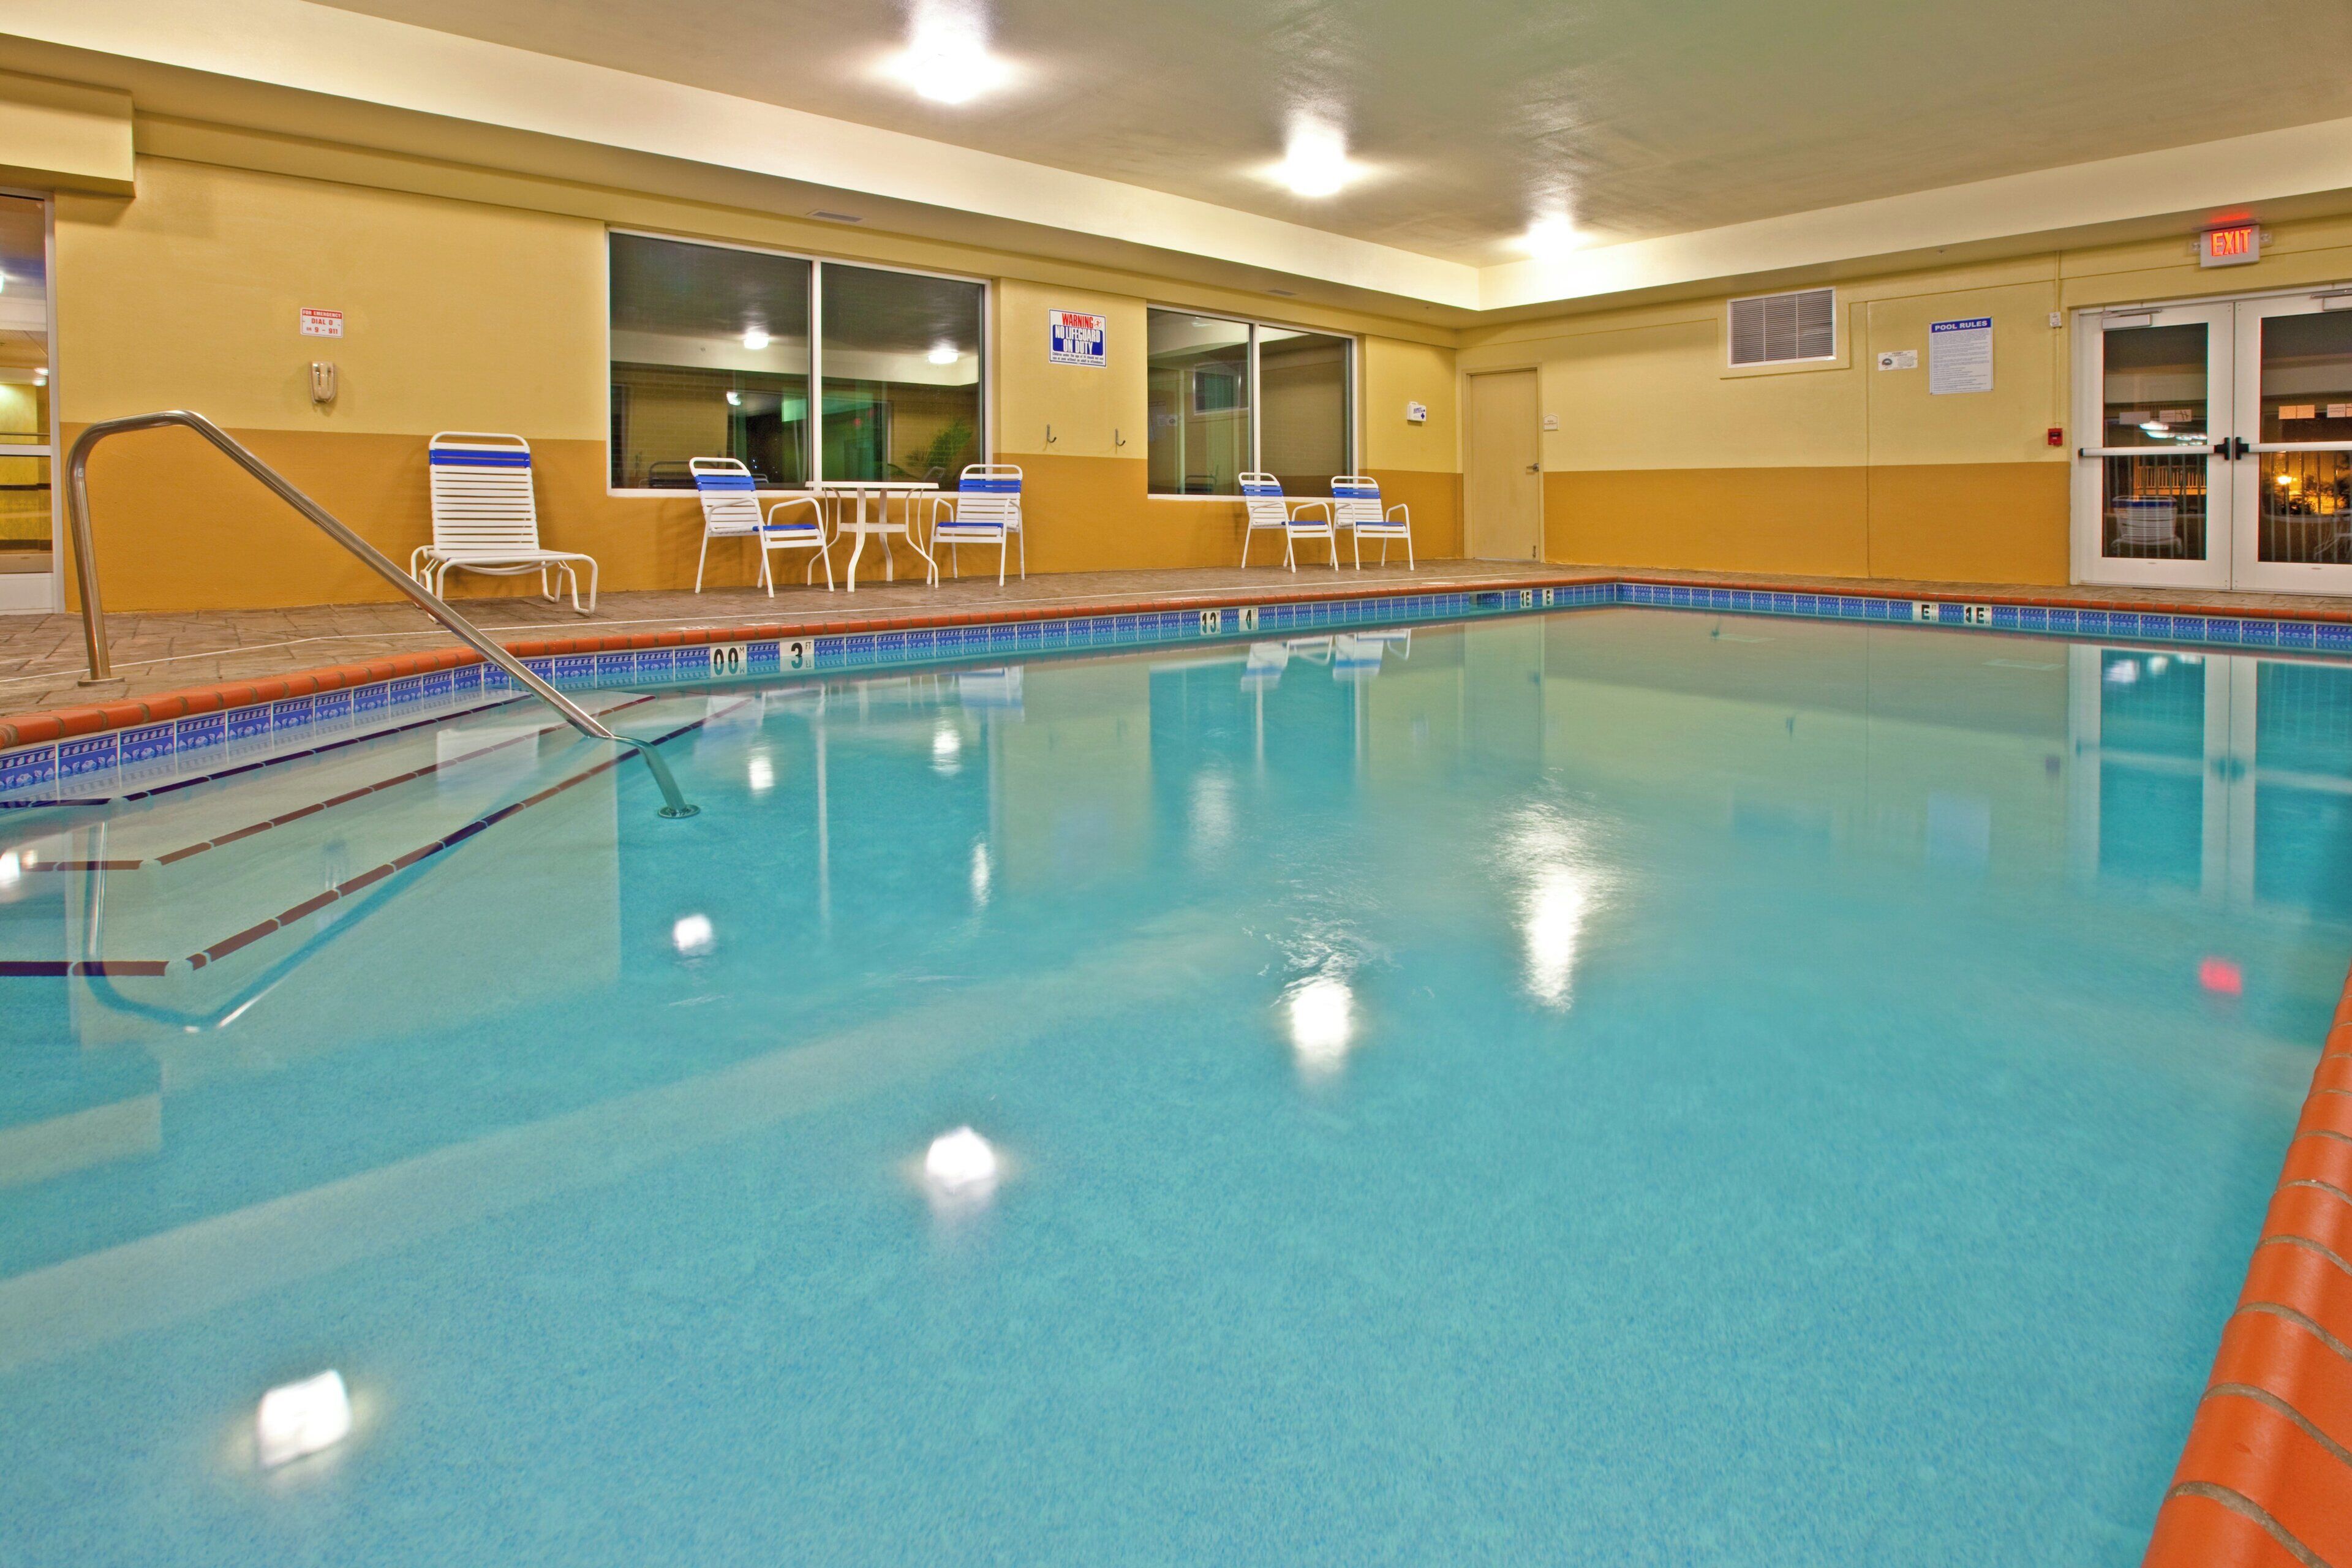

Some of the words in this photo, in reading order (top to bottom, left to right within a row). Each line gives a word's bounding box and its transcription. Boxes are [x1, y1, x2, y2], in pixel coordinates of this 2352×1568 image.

[2211, 228, 2252, 257] EXIT
[1061, 313, 1093, 328] WARNING
[1959, 320, 1988, 329] RULES
[1055, 325, 1065, 339] NO
[1065, 326, 1101, 343] LIFEGUARD
[1063, 339, 1073, 353] ON
[1075, 341, 1093, 355] DUTY
[805, 641, 812, 650] FT
